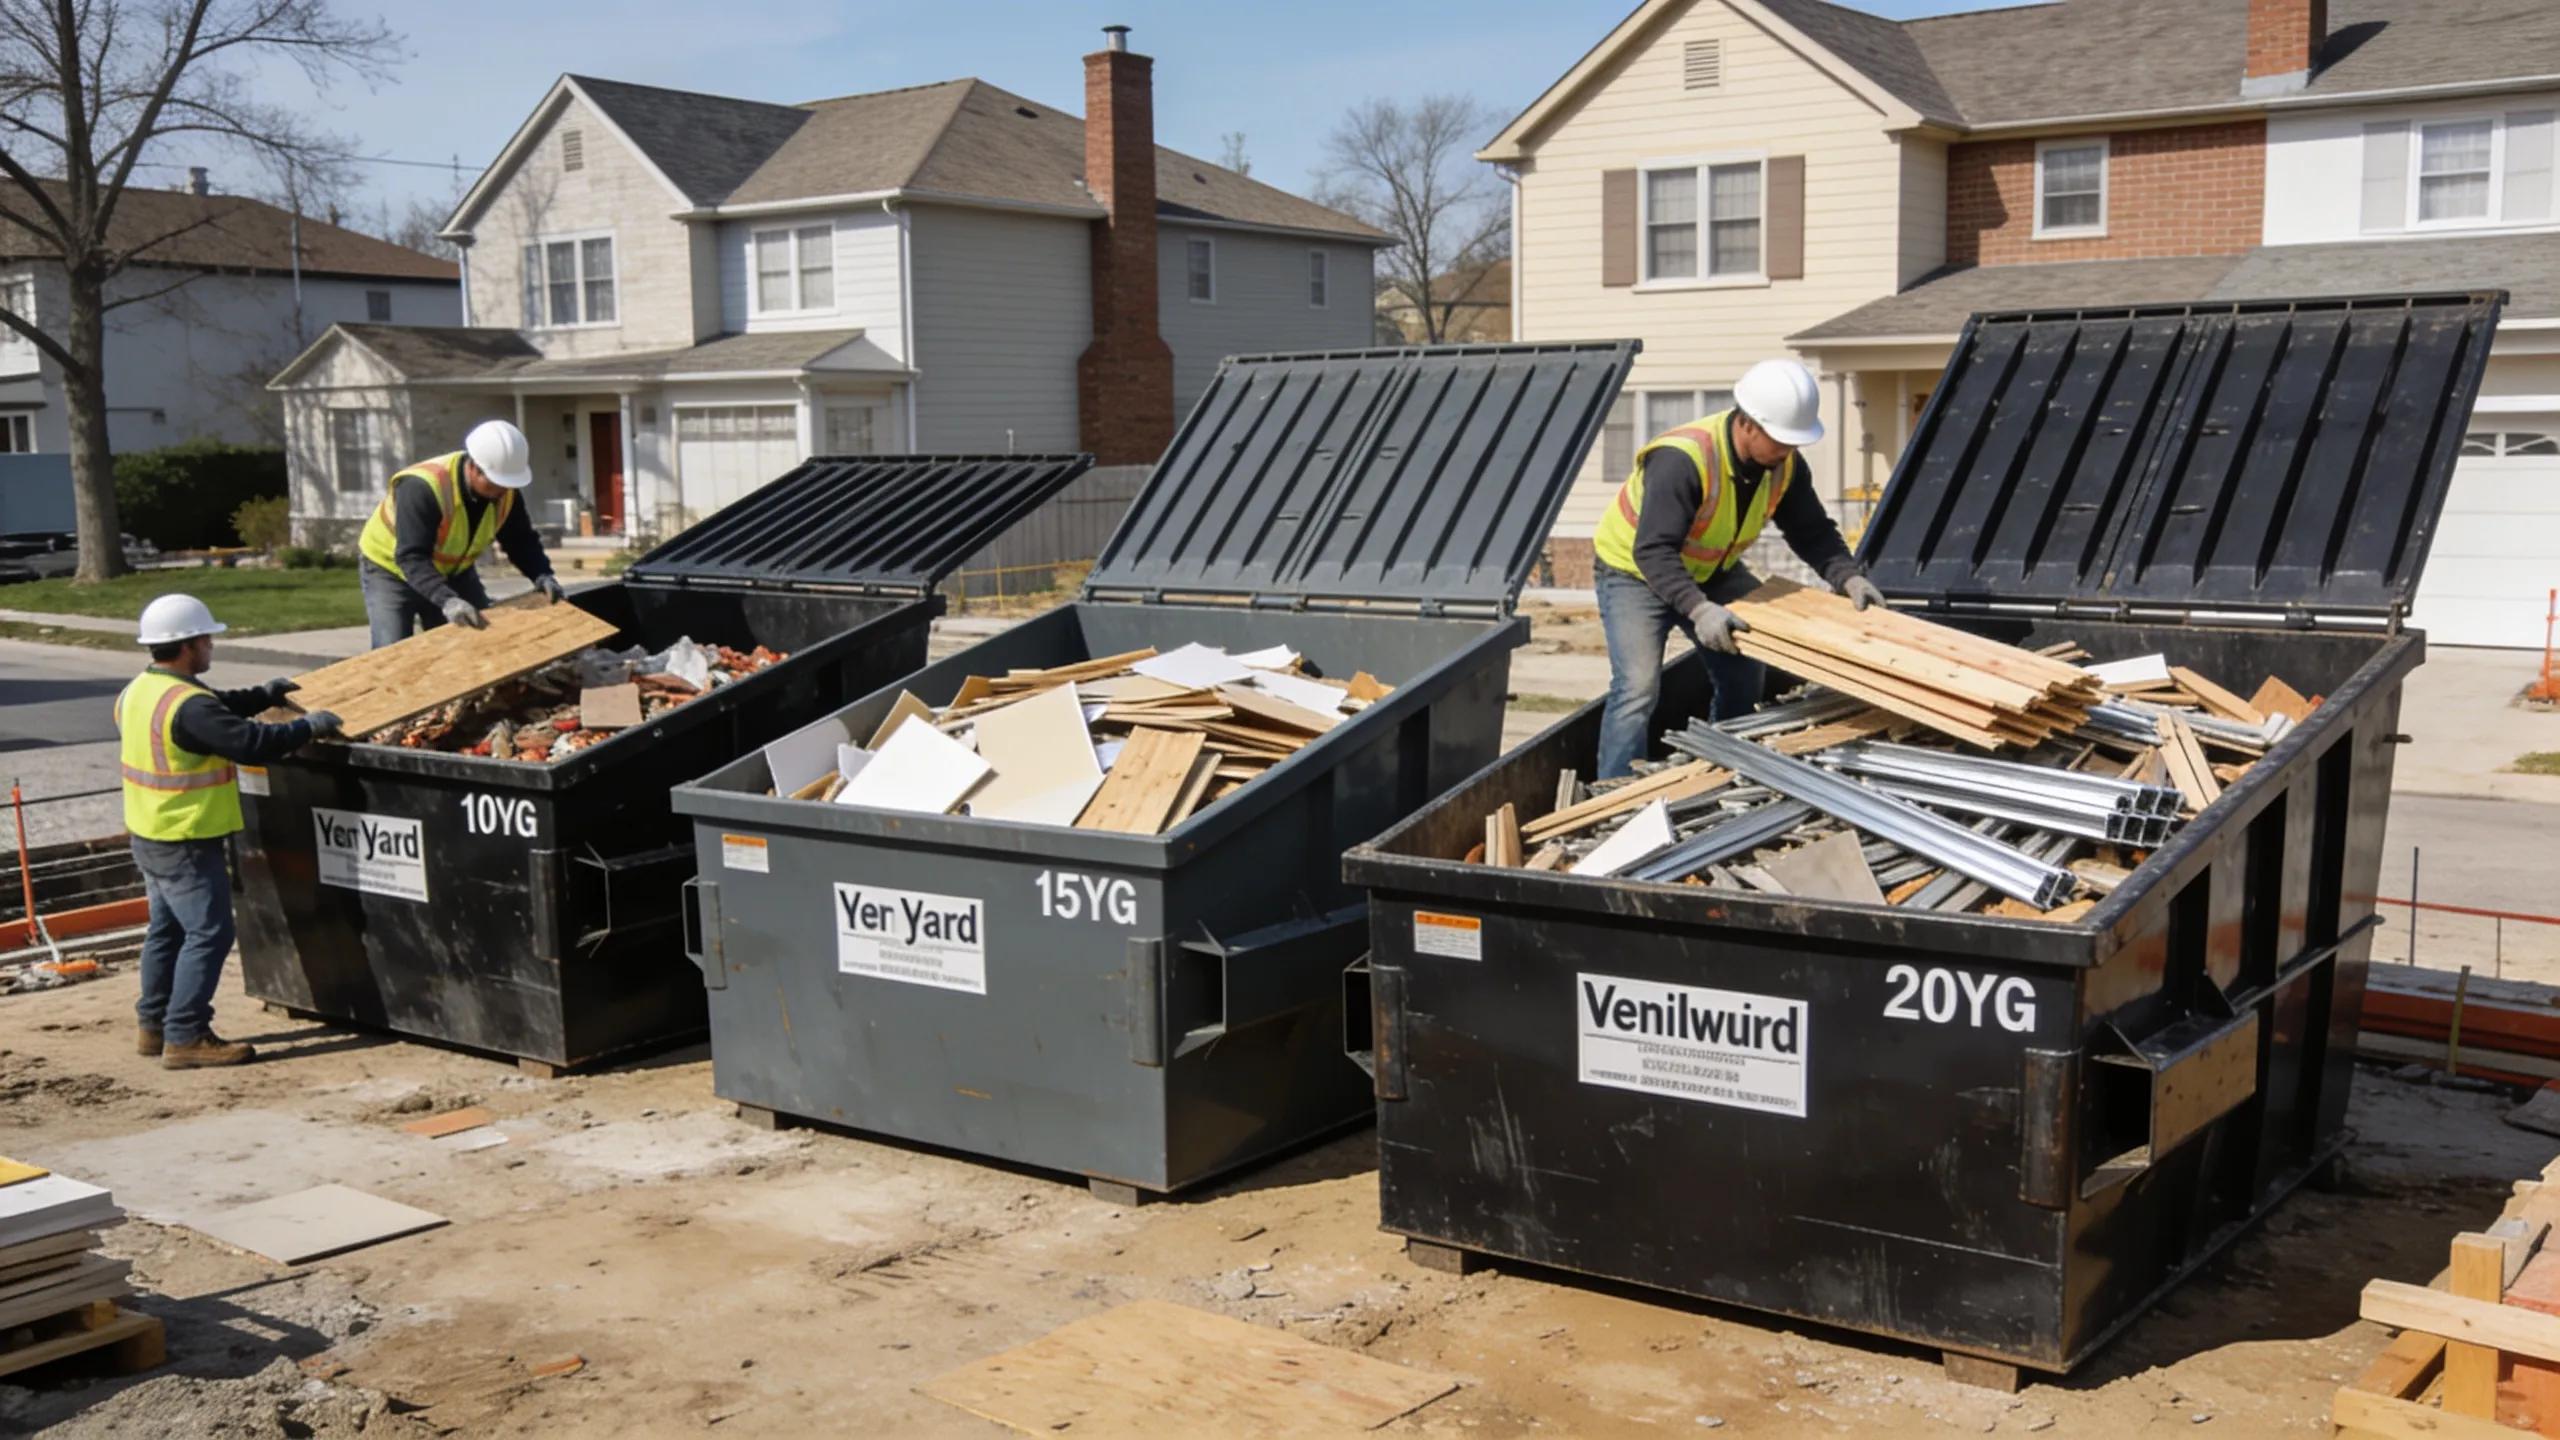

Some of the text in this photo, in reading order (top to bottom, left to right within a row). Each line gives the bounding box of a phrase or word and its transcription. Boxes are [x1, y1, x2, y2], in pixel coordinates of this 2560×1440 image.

[361, 820, 419, 861] Yard
[461, 794, 538, 838] 10YG
[900, 897, 977, 946] Yard
[1035, 869, 1137, 926] 15YG
[1882, 964, 2036, 1032] 20YG
